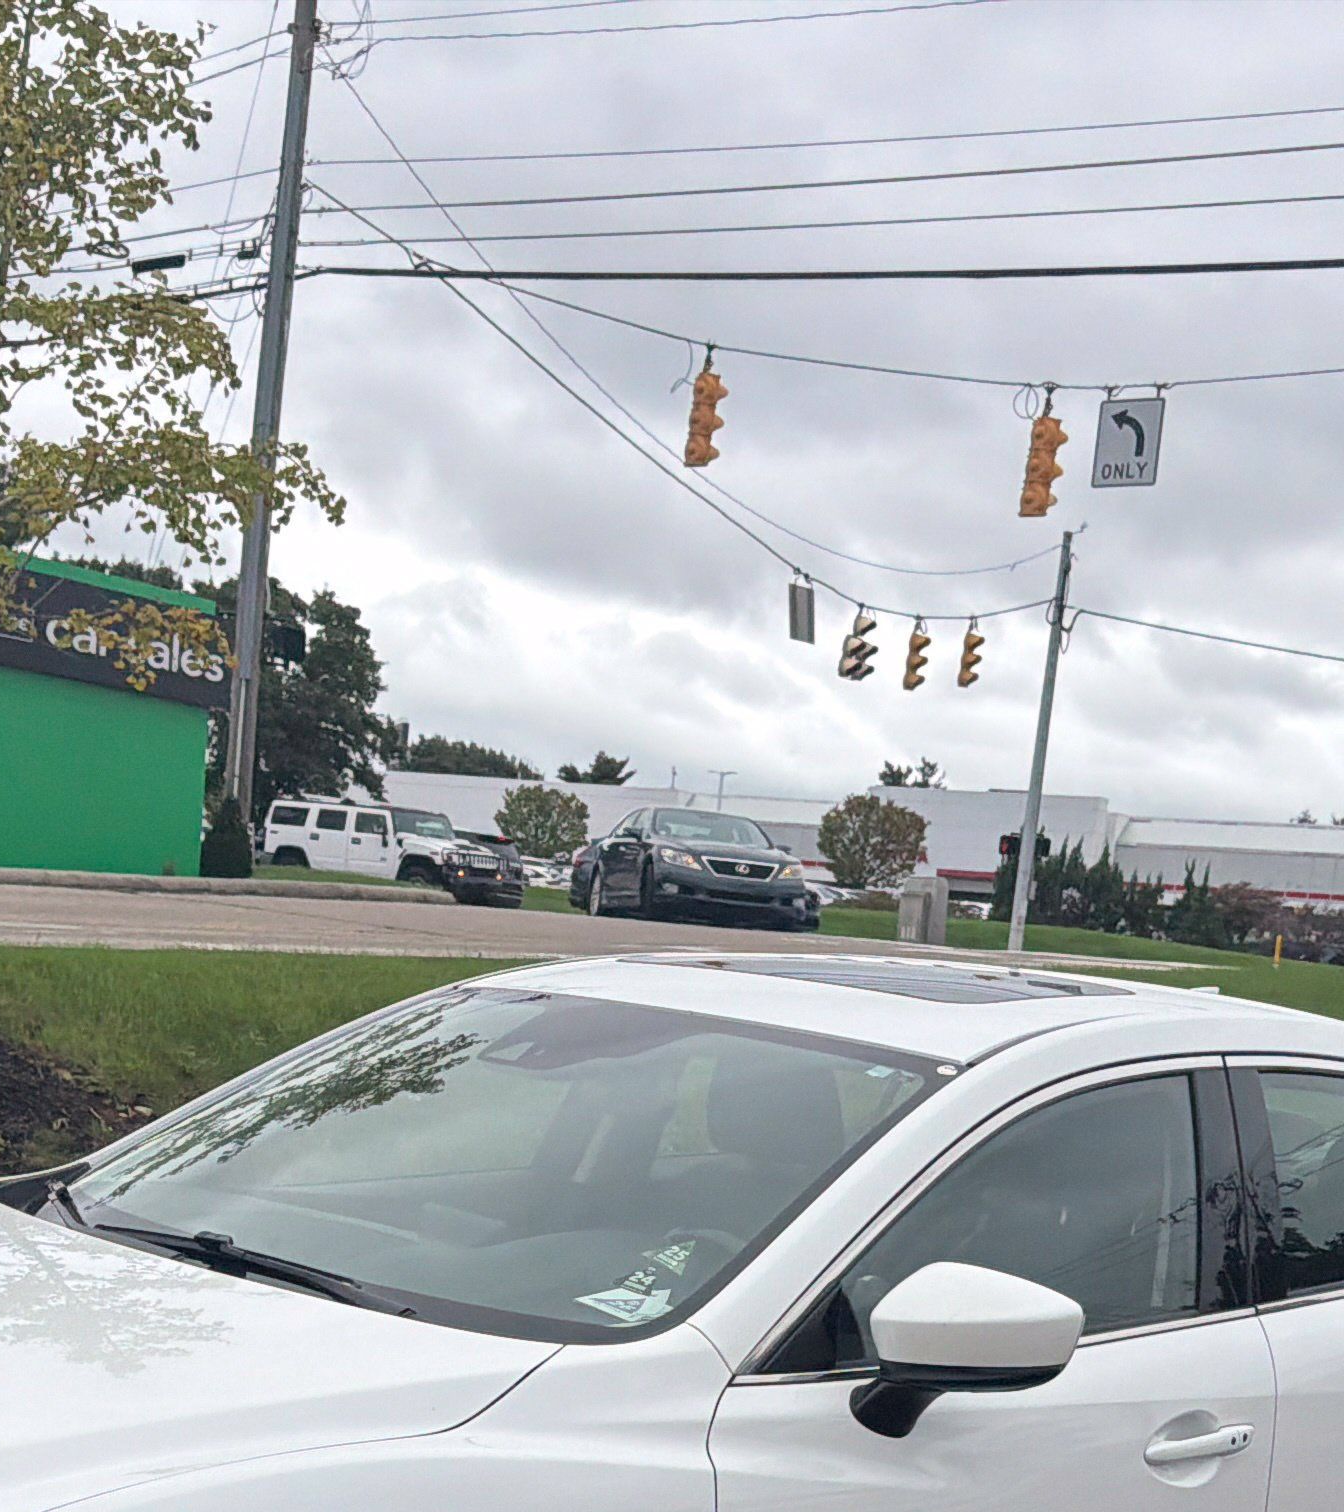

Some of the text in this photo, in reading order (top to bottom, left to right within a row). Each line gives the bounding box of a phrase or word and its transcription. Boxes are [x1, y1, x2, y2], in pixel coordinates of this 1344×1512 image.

[1101, 462, 1149, 480] ONLY
[127, 632, 224, 683] ales
[663, 1245, 691, 1261] 25
[628, 1271, 657, 1287] 24
